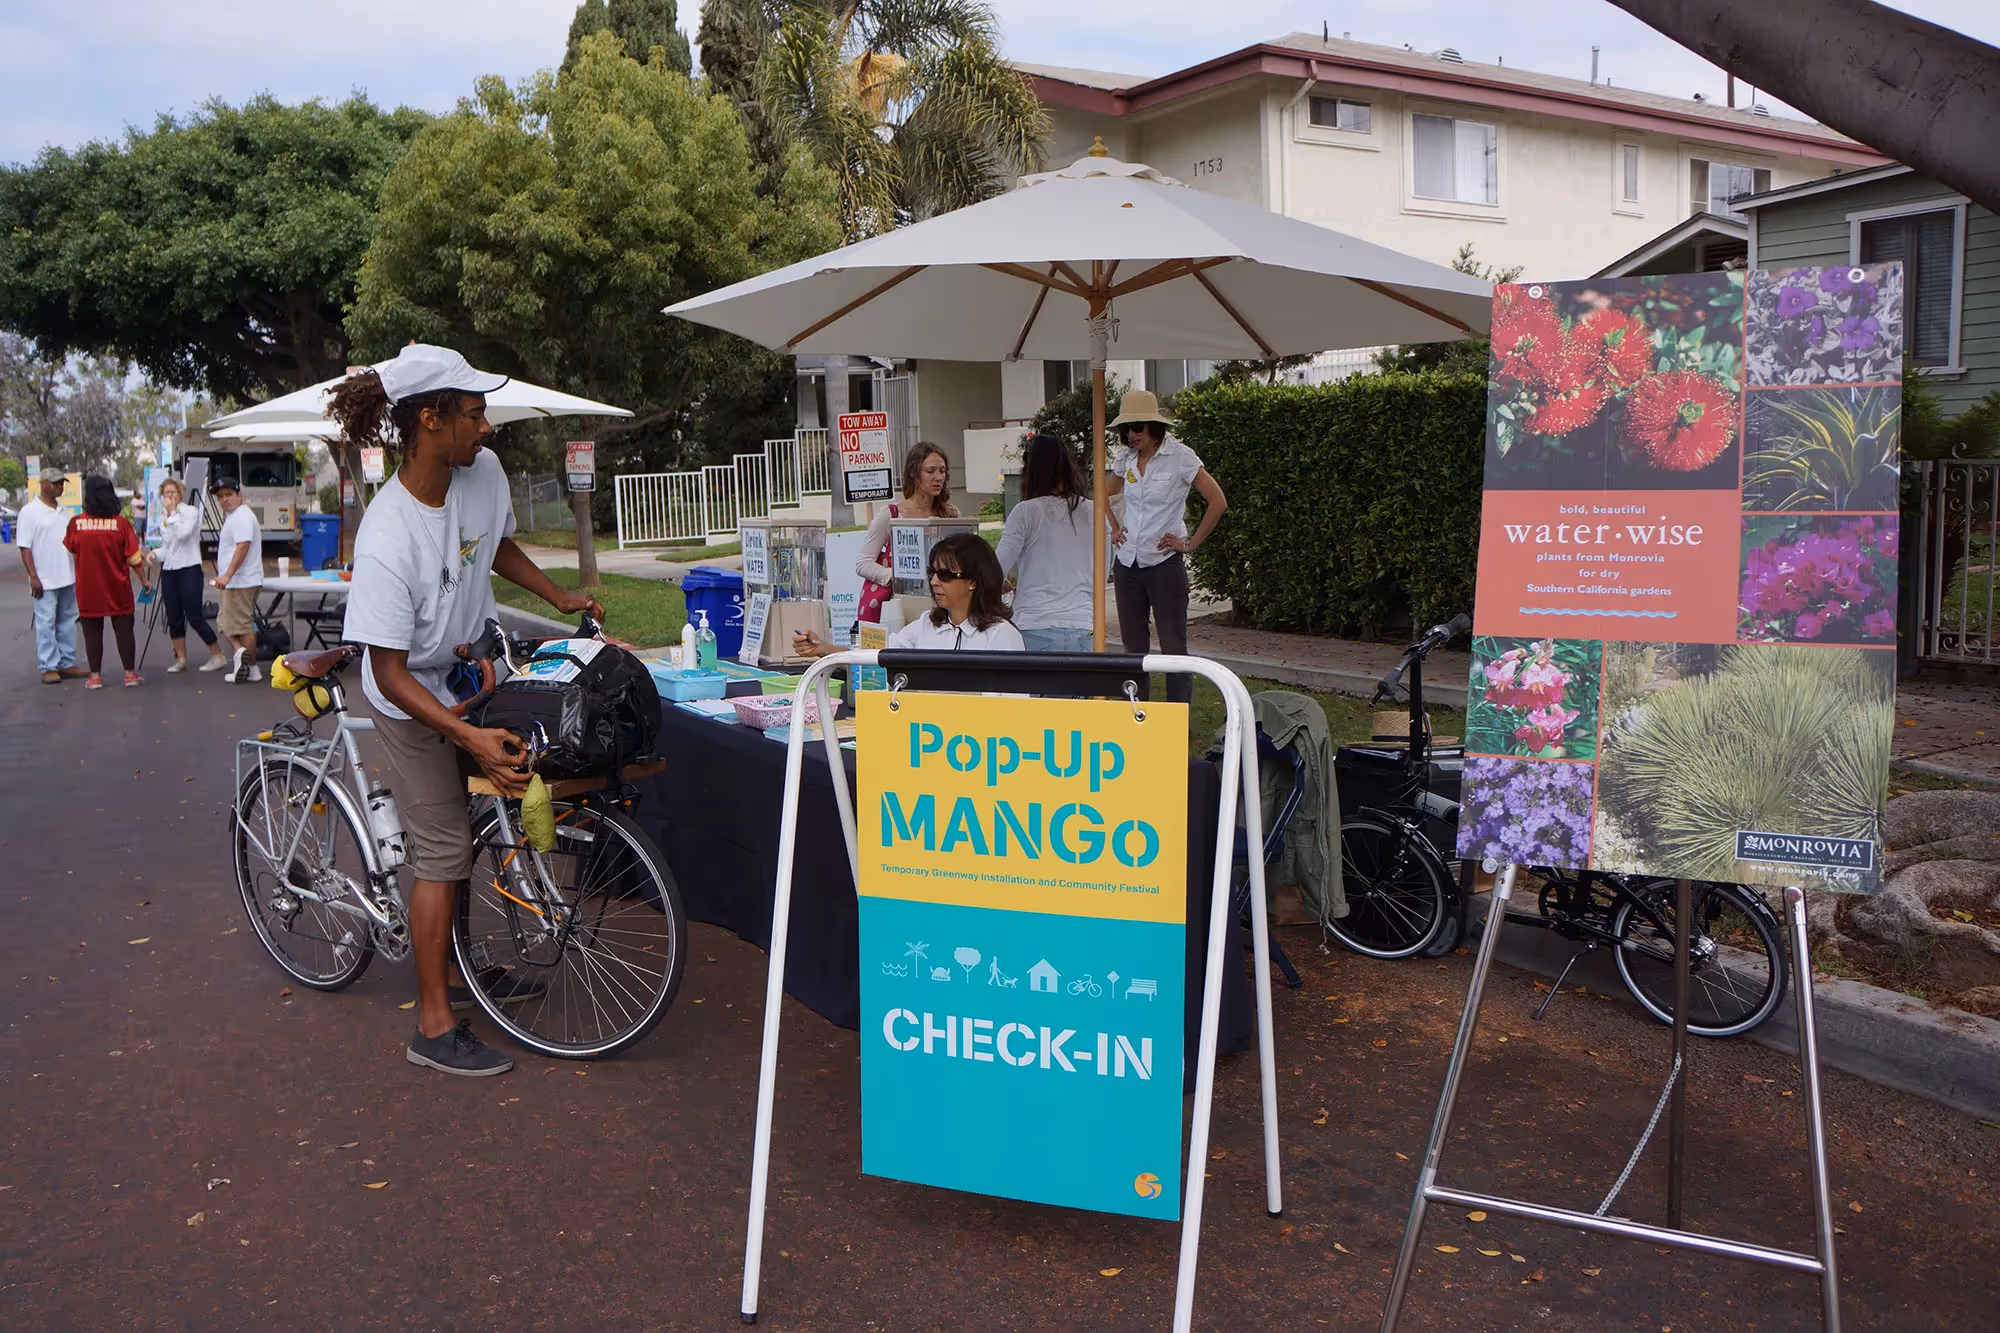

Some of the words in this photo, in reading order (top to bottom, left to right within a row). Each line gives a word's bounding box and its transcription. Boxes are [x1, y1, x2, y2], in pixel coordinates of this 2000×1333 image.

[1194, 157, 1223, 177] 1753
[842, 417, 860, 428] TOW
[862, 415, 884, 427] AWAY
[841, 432, 858, 451] NO
[848, 452, 885, 465] PARKING
[850, 489, 888, 499] TEMPORARY
[1560, 505, 1588, 515] bold,
[1593, 505, 1645, 514] beautiful
[75, 518, 118, 531] TROJANS
[745, 531, 763, 548] Drink
[897, 529, 919, 545] Drink
[898, 556, 920, 569] WATER
[1536, 553, 1572, 563] plants
[1576, 552, 1604, 562] from
[1609, 553, 1665, 563] Monrovia
[746, 560, 764, 573] WATER
[1579, 569, 1595, 577] for
[1600, 569, 1620, 579] dry
[1527, 584, 1574, 593] Southern
[1577, 585, 1628, 595] California
[1630, 587, 1672, 597] gardens
[831, 593, 854, 602] NOTICE
[909, 721, 1125, 793] Pop-Up
[881, 863, 930, 878] Temporary
[931, 868, 978, 882] Greenway
[981, 872, 1036, 885] Installation
[1038, 877, 1057, 887] and
[1059, 878, 1117, 893] Community
[1119, 883, 1160, 894] Festival
[883, 1007, 1153, 1081] CHECK-IN
